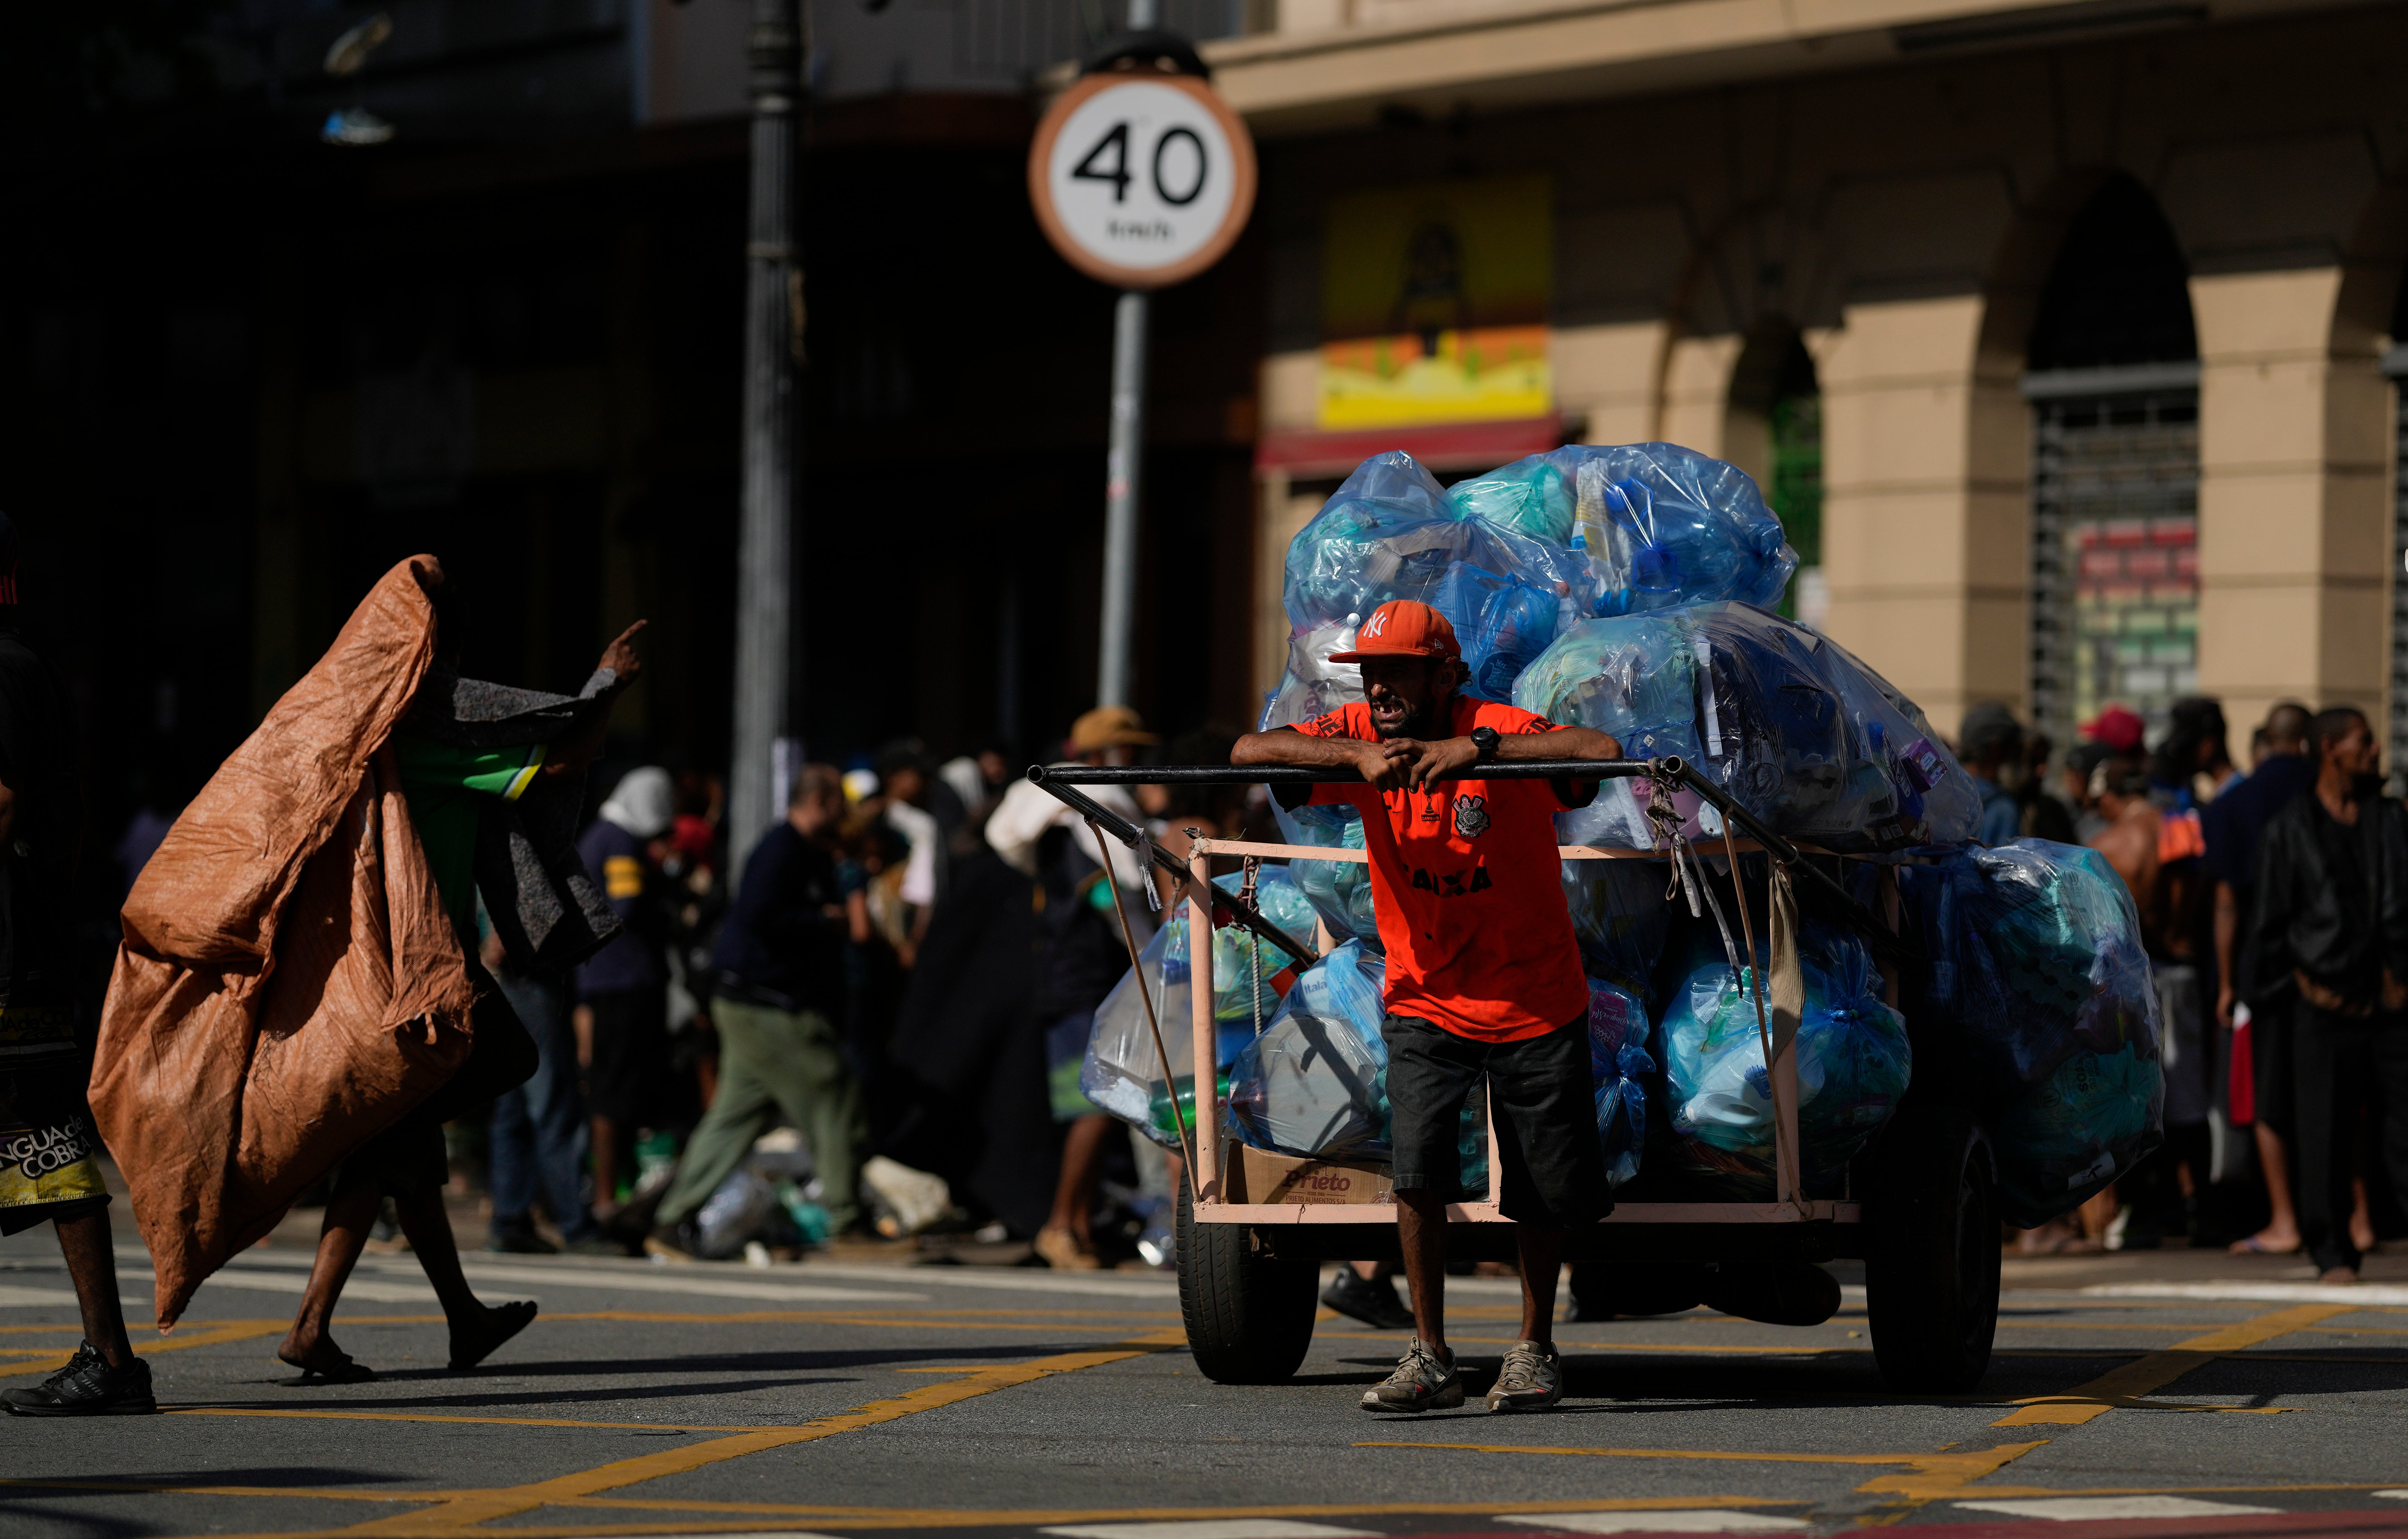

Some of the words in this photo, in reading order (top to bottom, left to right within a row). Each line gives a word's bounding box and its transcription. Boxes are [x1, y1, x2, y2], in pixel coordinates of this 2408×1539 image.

[1071, 122, 1206, 205] 40
[1363, 611, 1387, 638] NY
[1403, 862, 1493, 897] AIXA
[1591, 1008, 1606, 1020] Mel
[1609, 1013, 1626, 1025] Pingo
[22, 1134, 91, 1177] COBRA
[1282, 1170, 1351, 1191] Prieto
